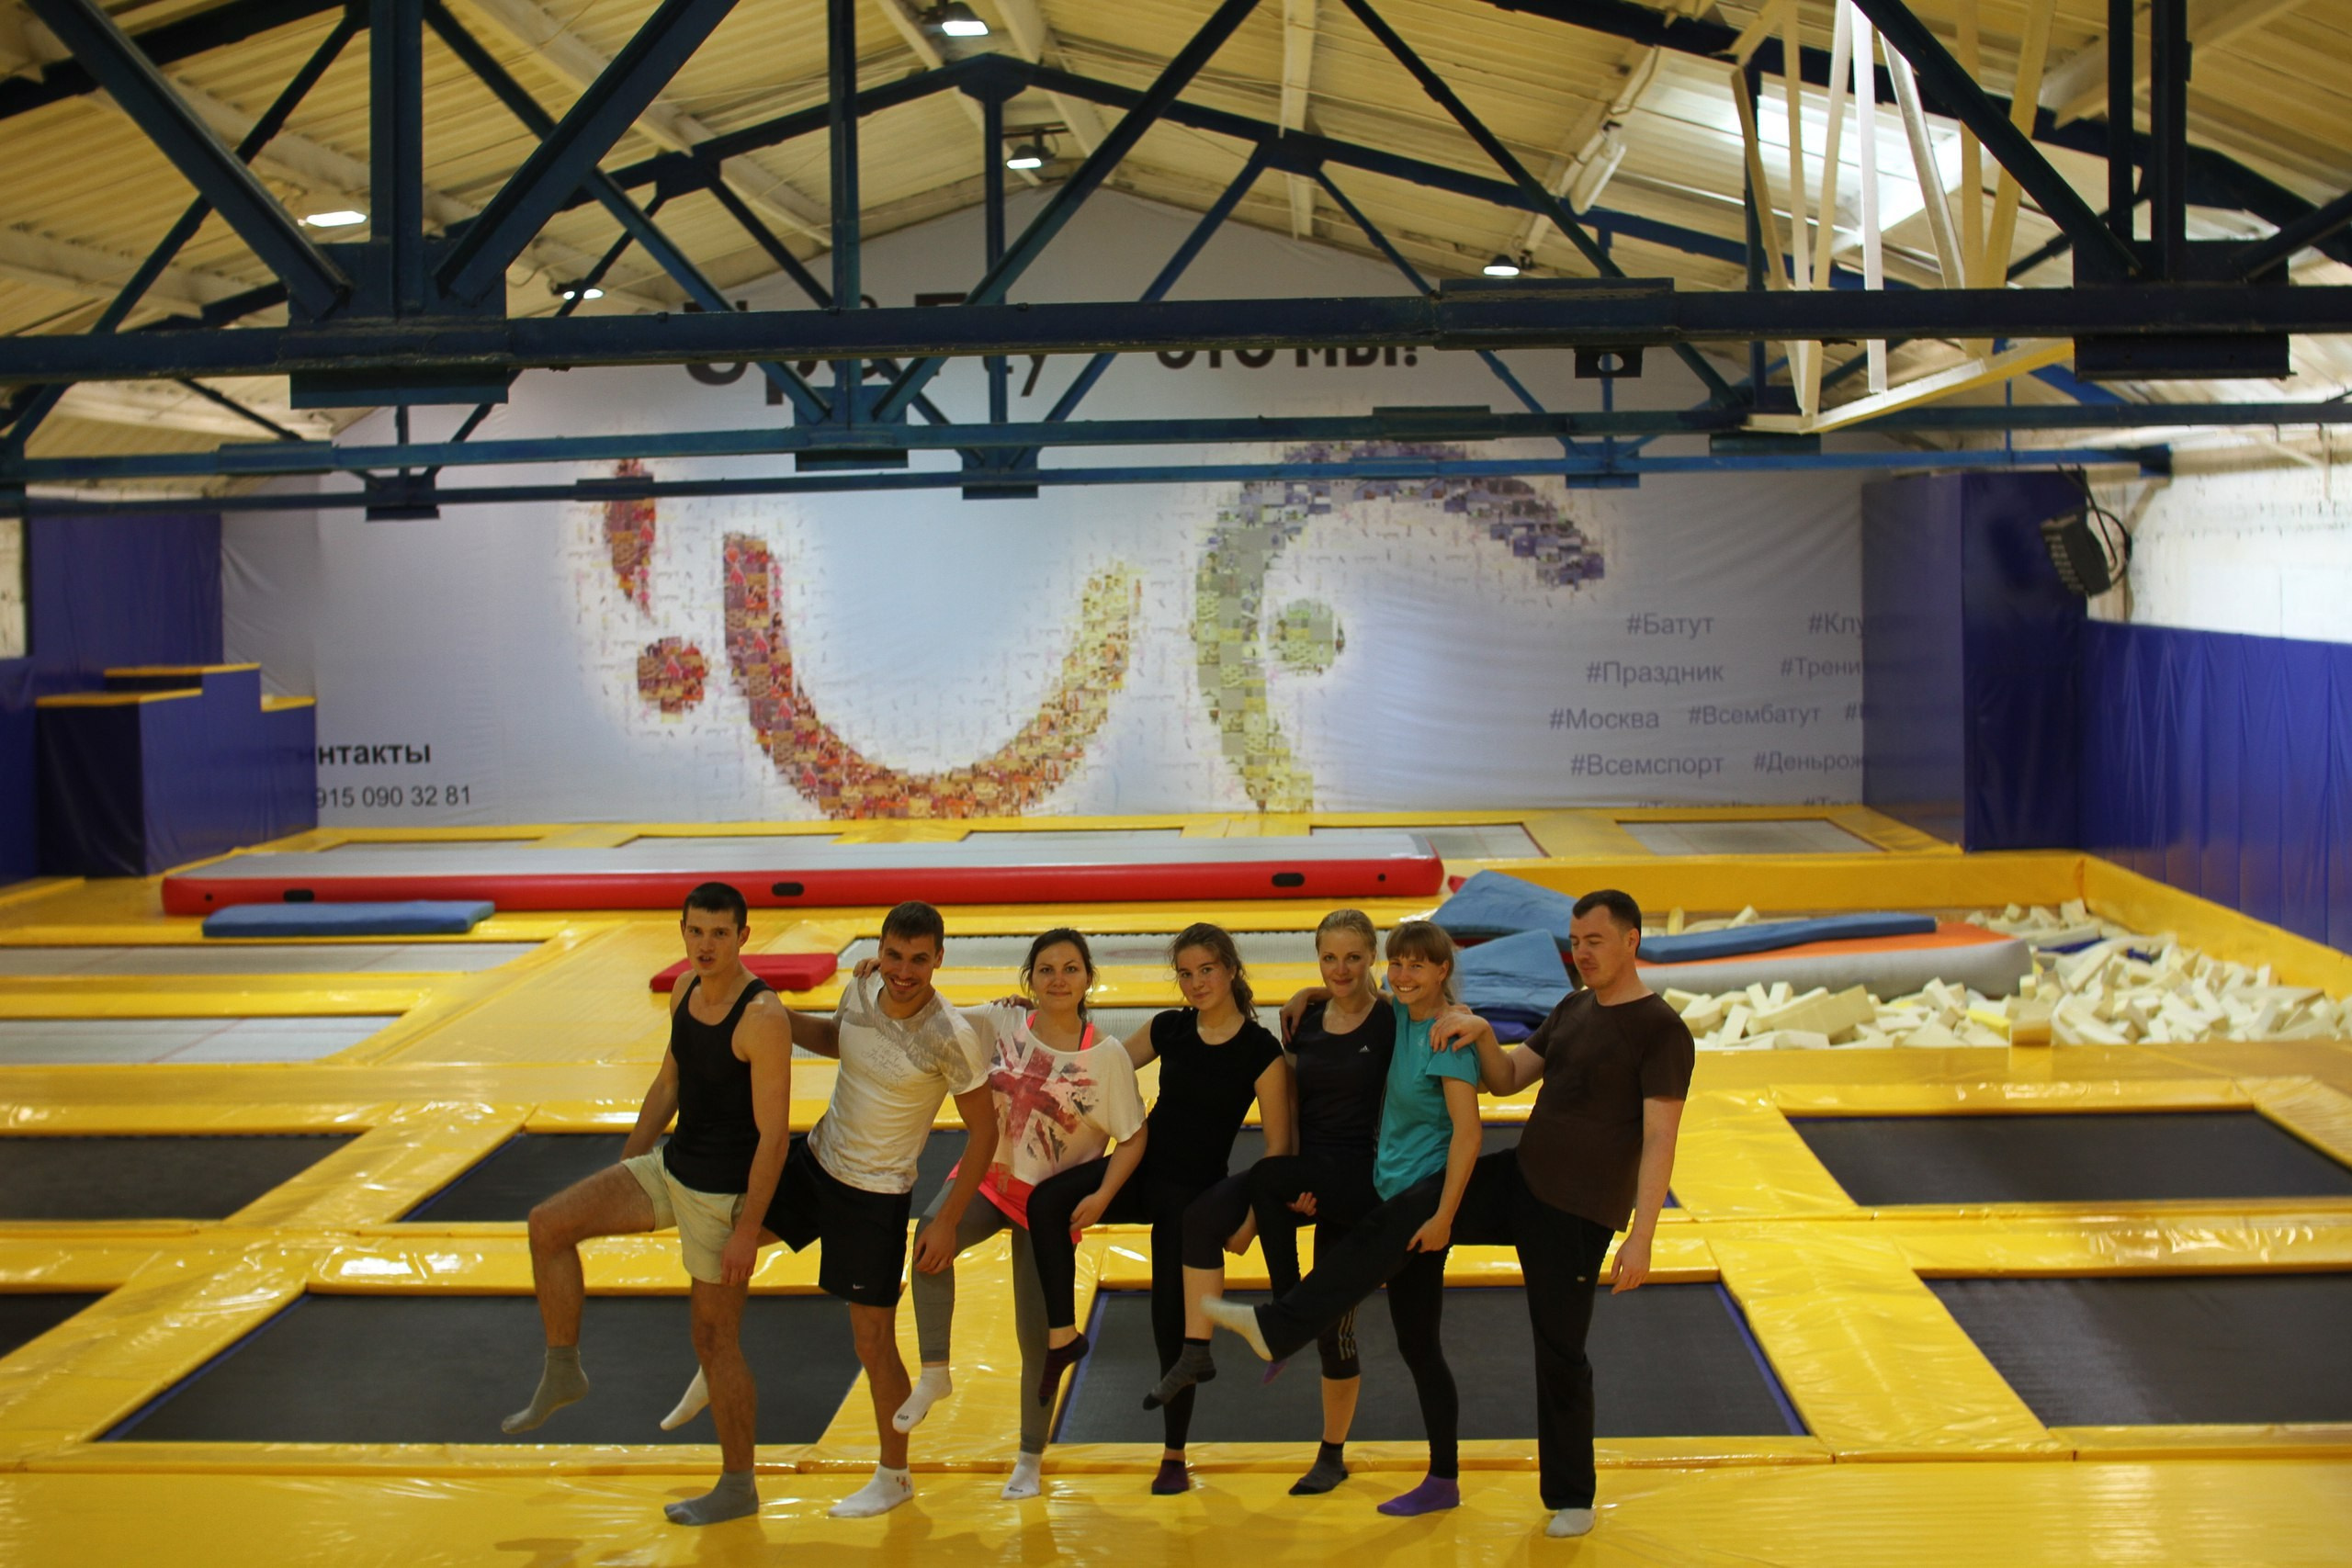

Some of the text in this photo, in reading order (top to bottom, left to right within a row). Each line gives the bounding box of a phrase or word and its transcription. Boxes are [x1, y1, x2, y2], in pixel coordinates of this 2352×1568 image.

[1625, 613, 1714, 637] #Батут
[1586, 661, 1724, 688] #Праздник
[1780, 656, 1861, 681] #Трени
[1549, 707, 1660, 731] #Москва
[1688, 704, 1821, 728] #Всембатут
[317, 743, 431, 765] нтакты
[1569, 750, 1863, 779] #Всемспорт #Деньрож
[362, 785, 403, 807] 090
[411, 784, 438, 807] 32
[445, 784, 470, 806] 81
